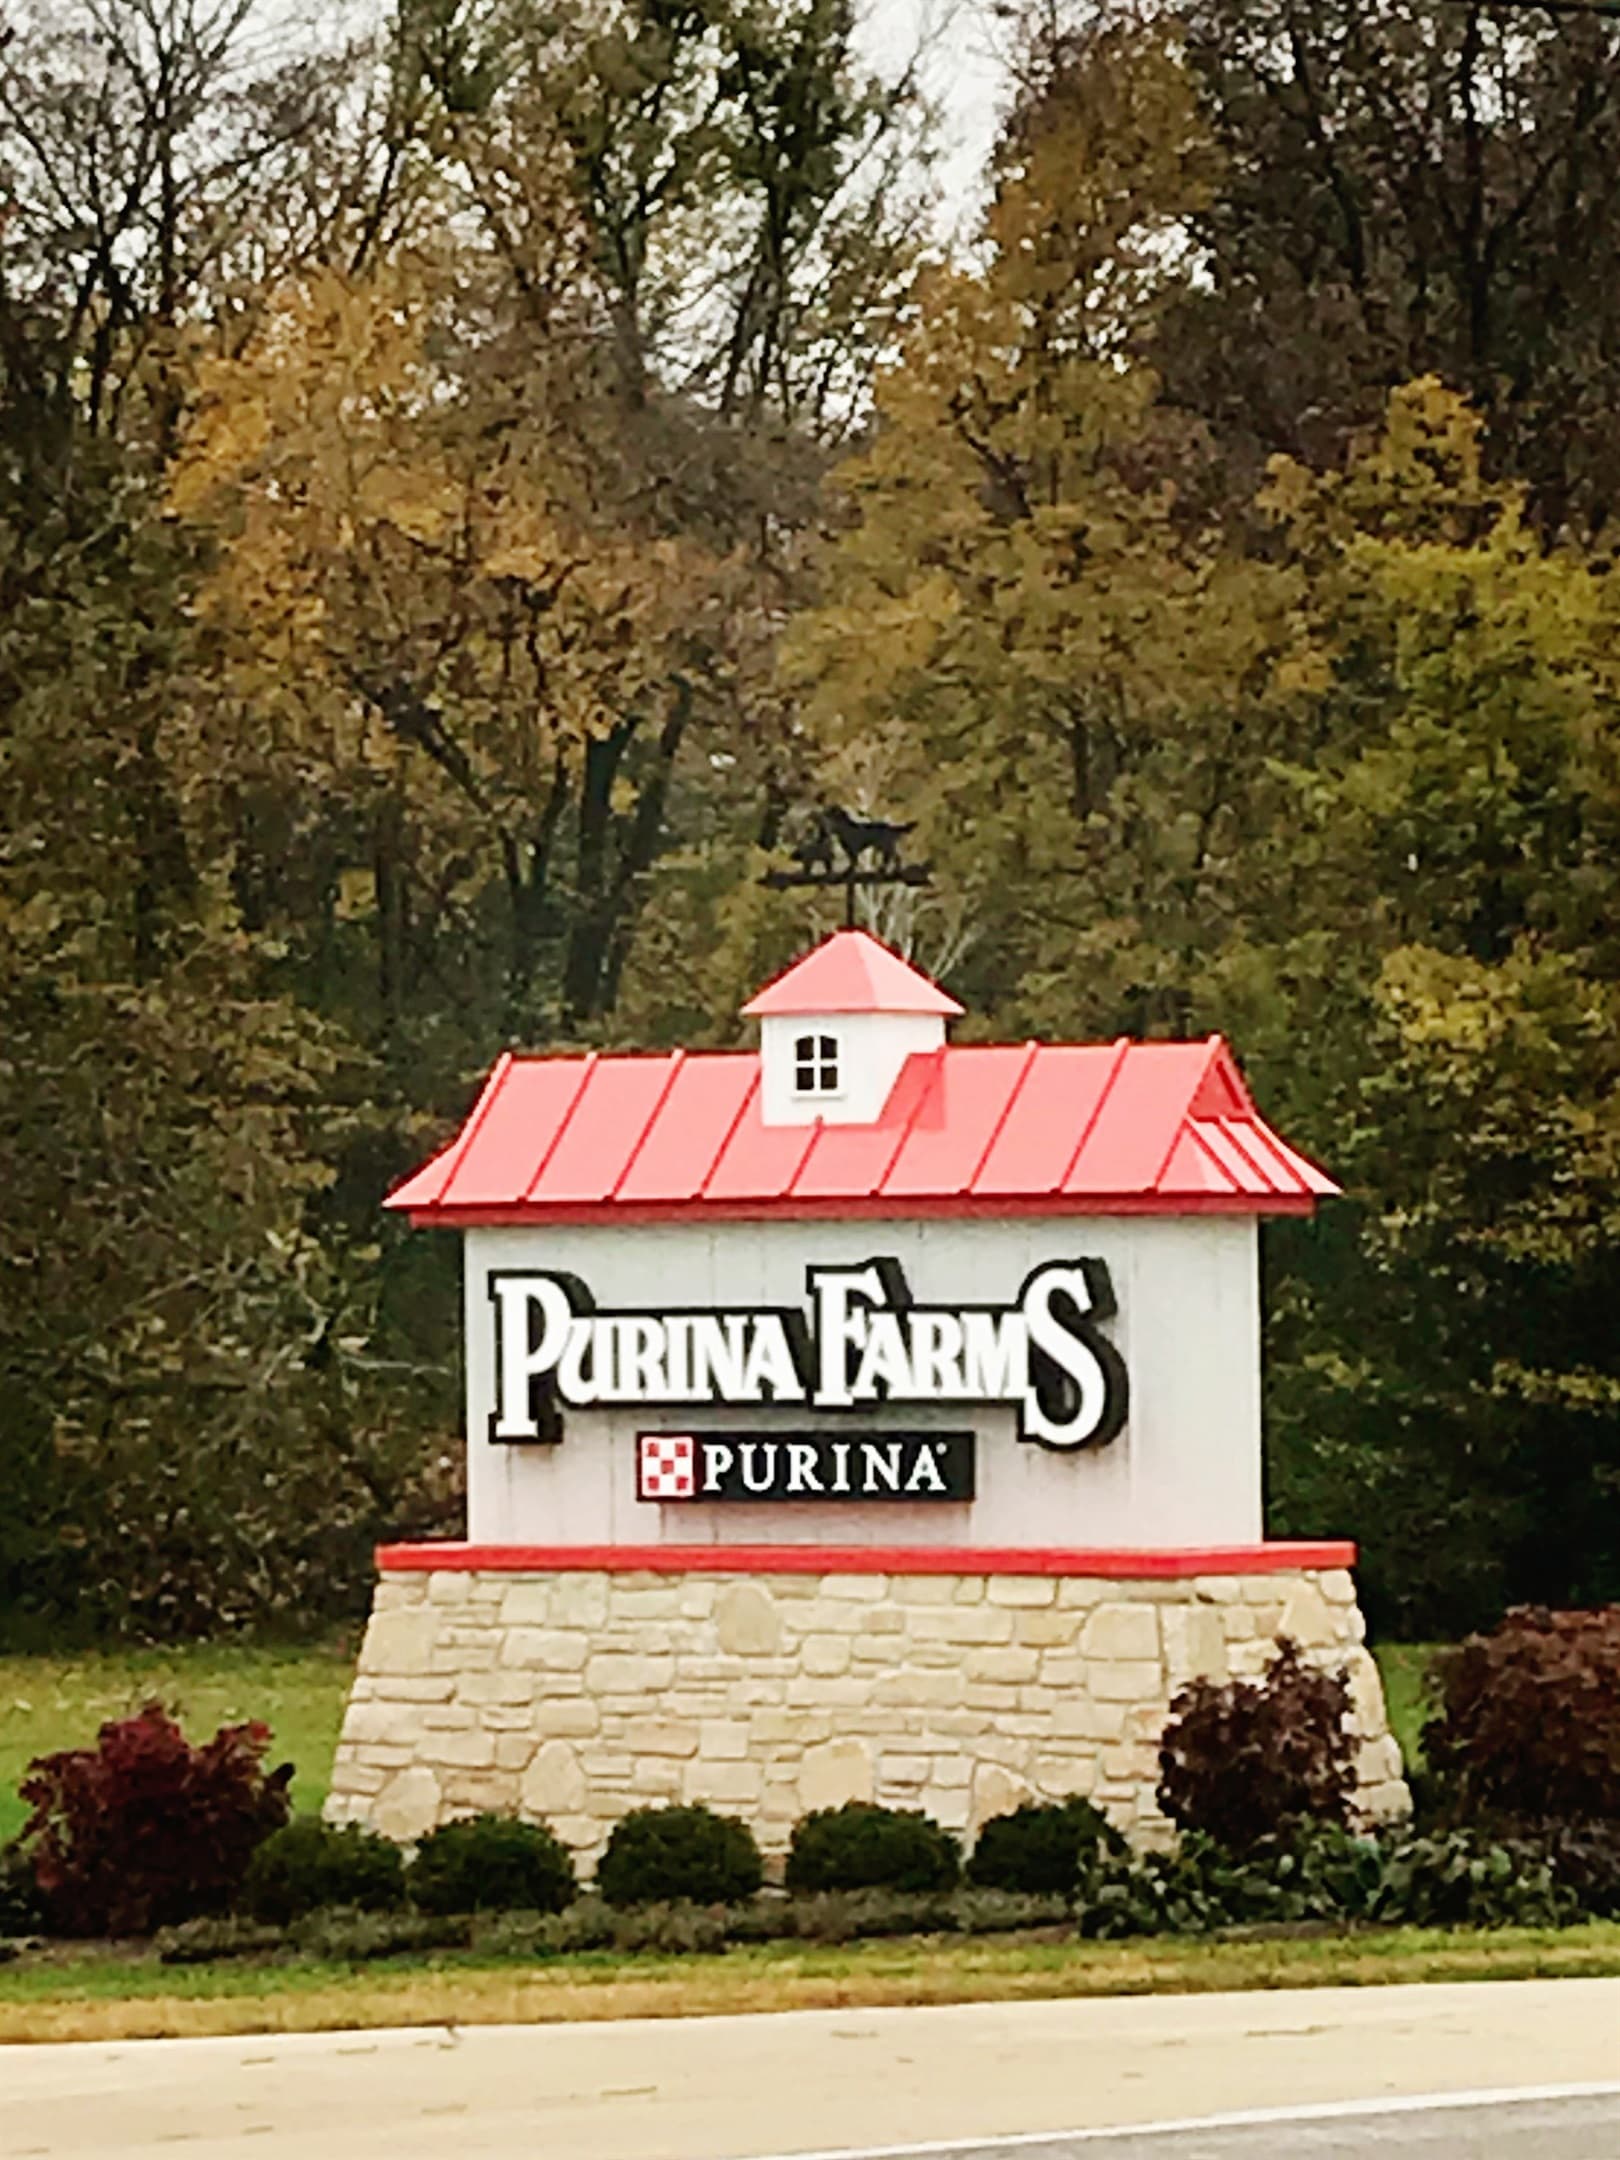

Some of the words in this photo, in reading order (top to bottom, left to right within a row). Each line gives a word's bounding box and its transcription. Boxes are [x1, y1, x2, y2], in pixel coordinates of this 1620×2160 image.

[493, 1276, 807, 1439] PURINA
[811, 1265, 1107, 1447] FARMS
[701, 1442, 948, 1493] PURINA
